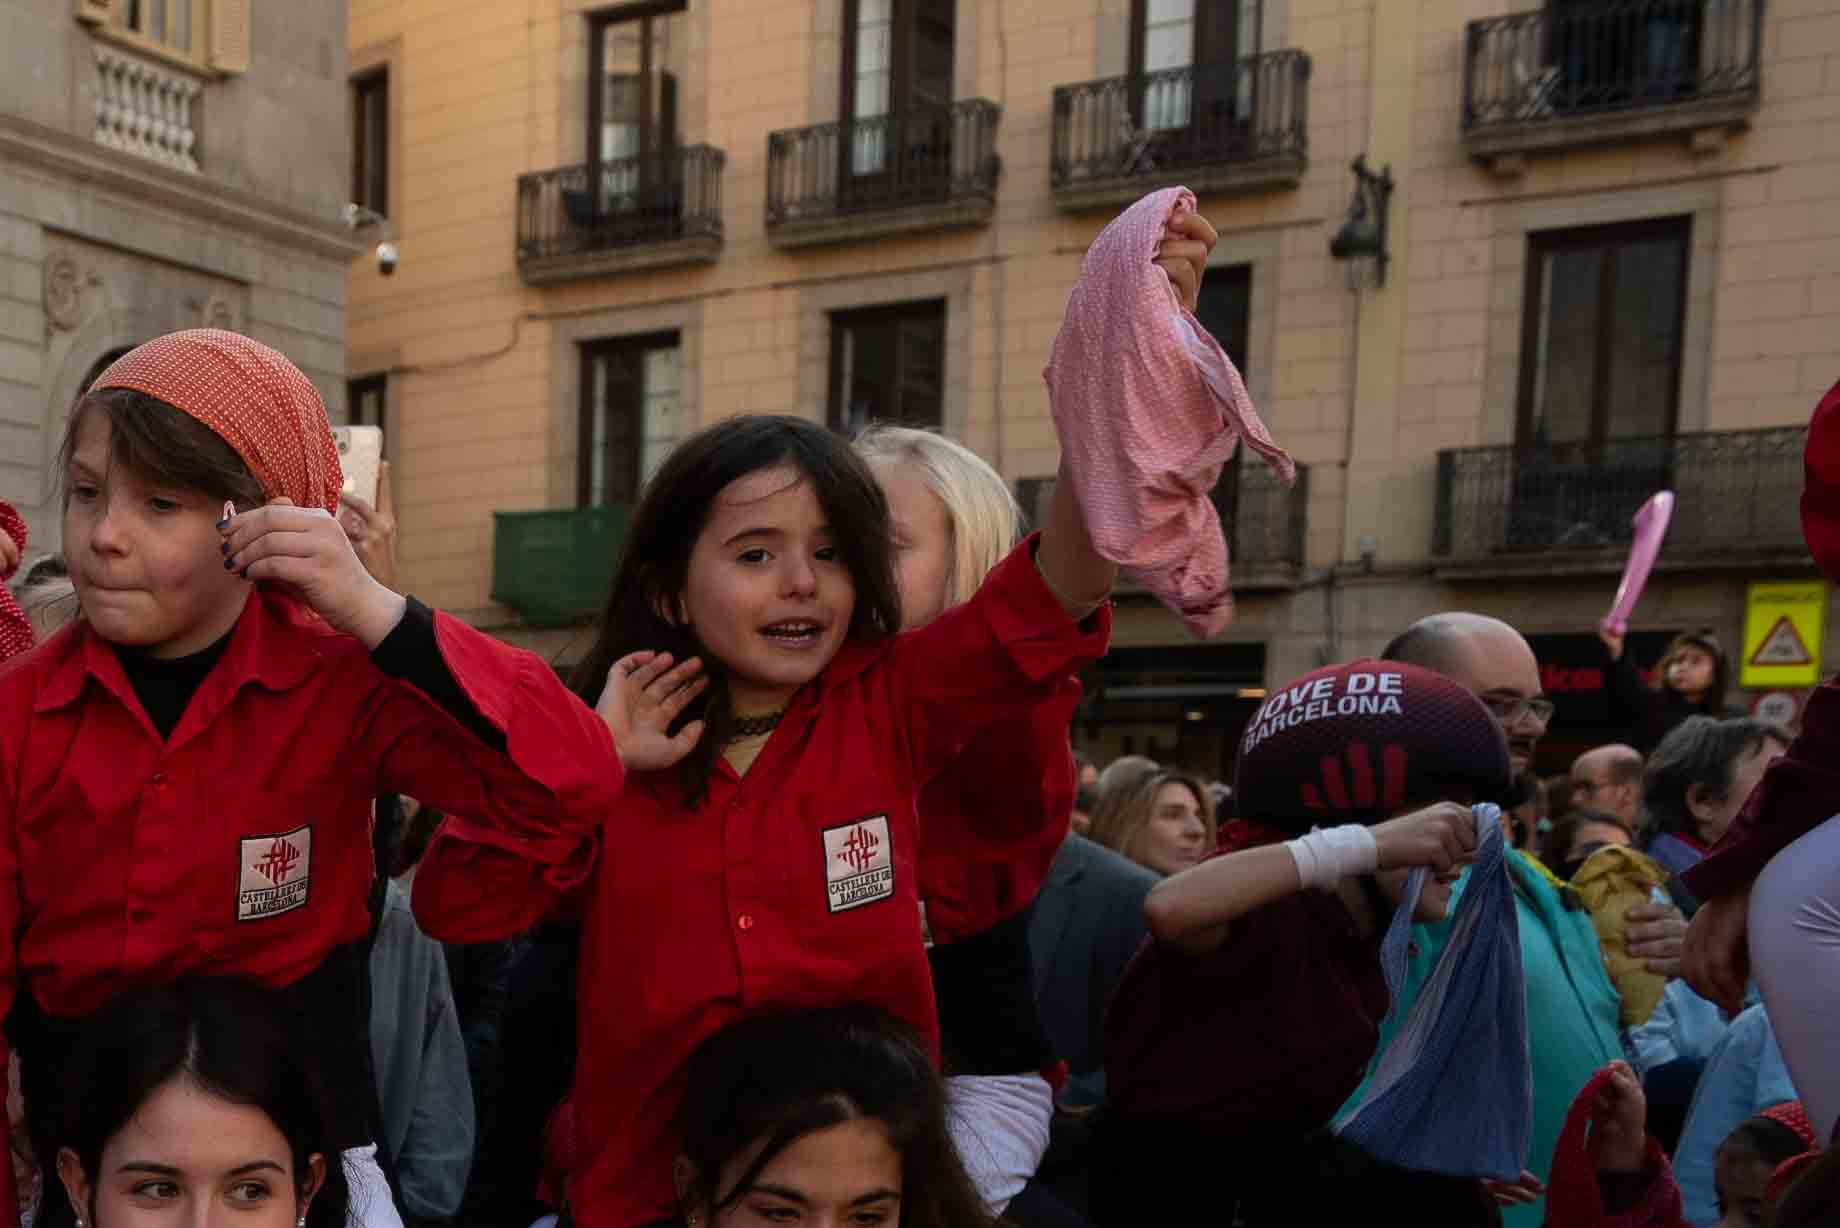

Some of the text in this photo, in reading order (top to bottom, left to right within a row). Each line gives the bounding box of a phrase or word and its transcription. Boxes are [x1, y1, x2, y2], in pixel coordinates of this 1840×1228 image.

[1244, 695, 1402, 755] BARCELONA
[1248, 672, 1403, 733] JOVE DE
[830, 871, 880, 895] CASTELLERS
